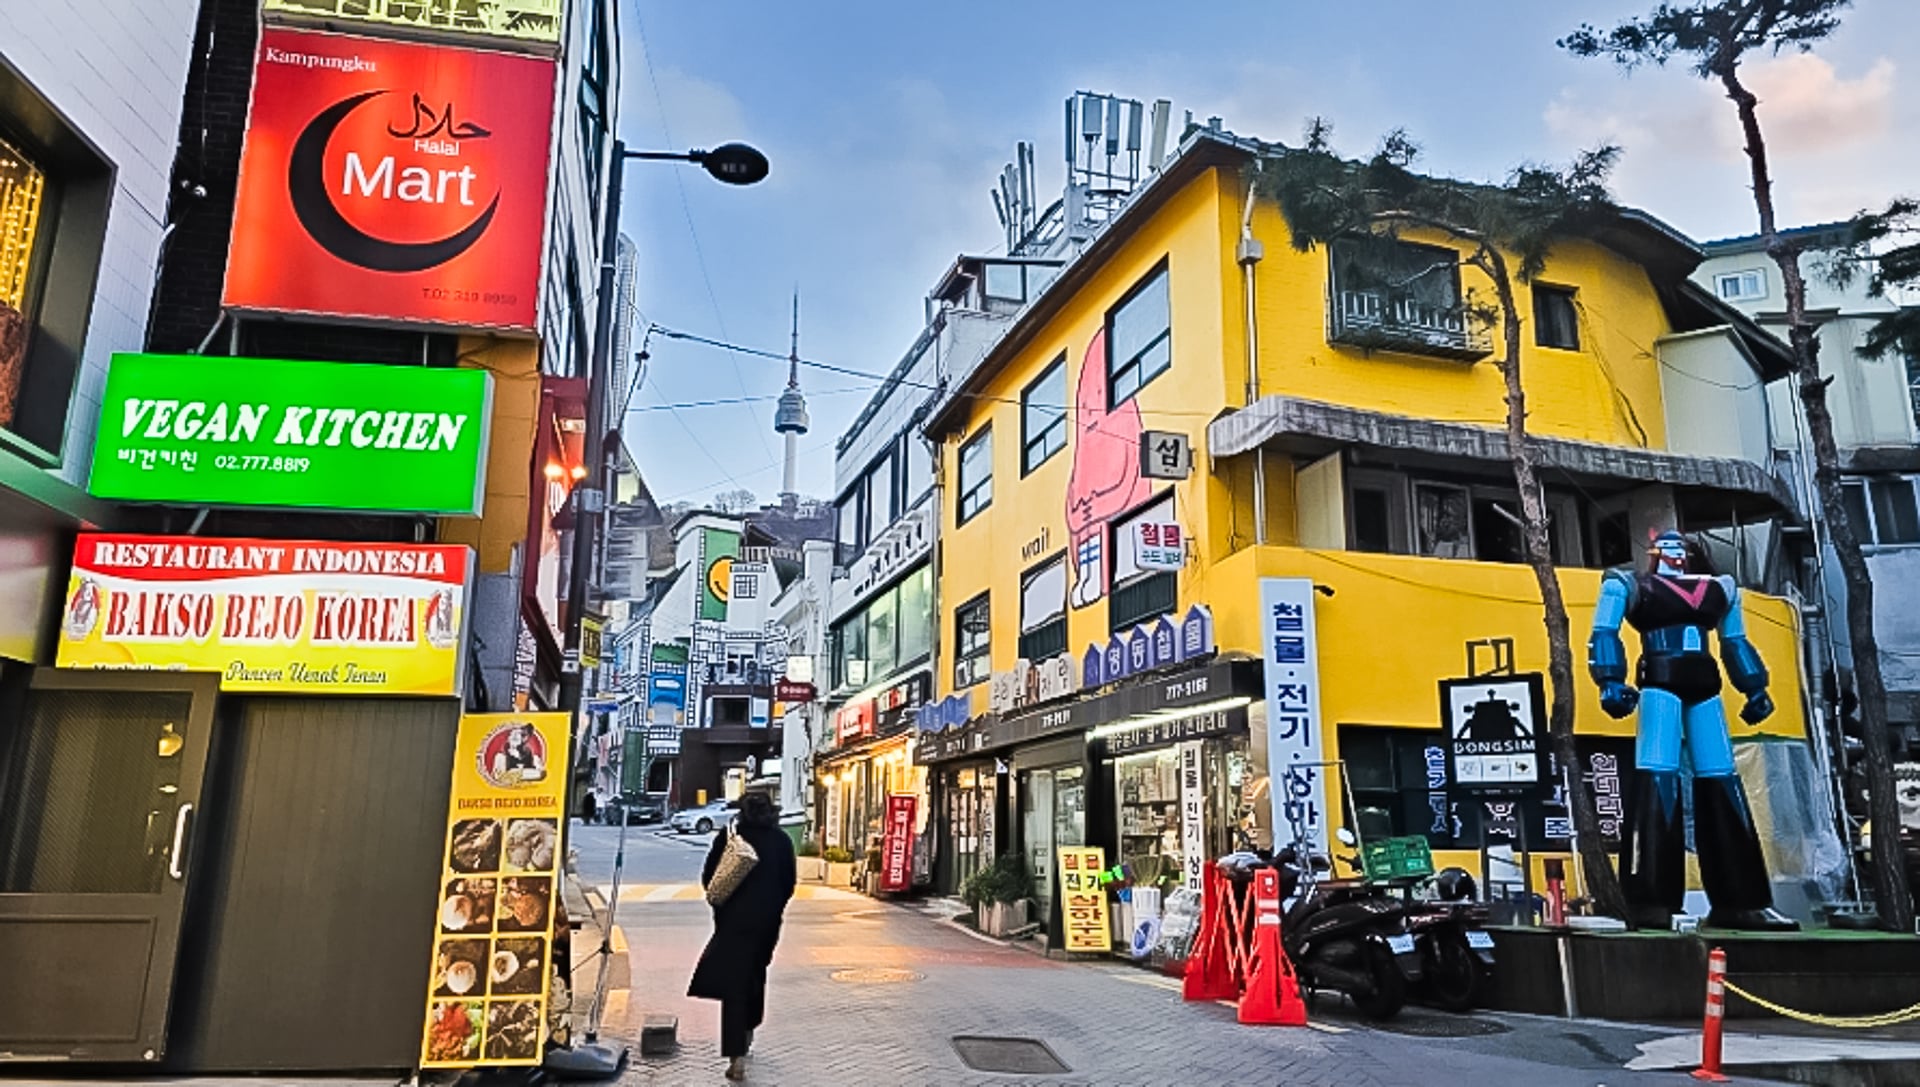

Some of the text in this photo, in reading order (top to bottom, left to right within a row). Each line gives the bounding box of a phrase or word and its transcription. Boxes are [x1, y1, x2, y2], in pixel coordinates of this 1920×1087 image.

[266, 48, 377, 72] Kampungku
[387, 92, 491, 139] حلال
[415, 140, 460, 156] Halal
[342, 152, 476, 206] Mart
[122, 398, 467, 450] VEGAN KITCHEN
[118, 449, 311, 472] 비건키친 02.777.8819
[1156, 439, 1180, 468] 섬
[1022, 526, 1050, 561] wait
[1140, 523, 1180, 548] 철물
[94, 541, 445, 574] RESTAURANT INDONESIA
[105, 591, 416, 643] BAKSO BEJO KOREA
[1454, 739, 1536, 754] DONGSIM
